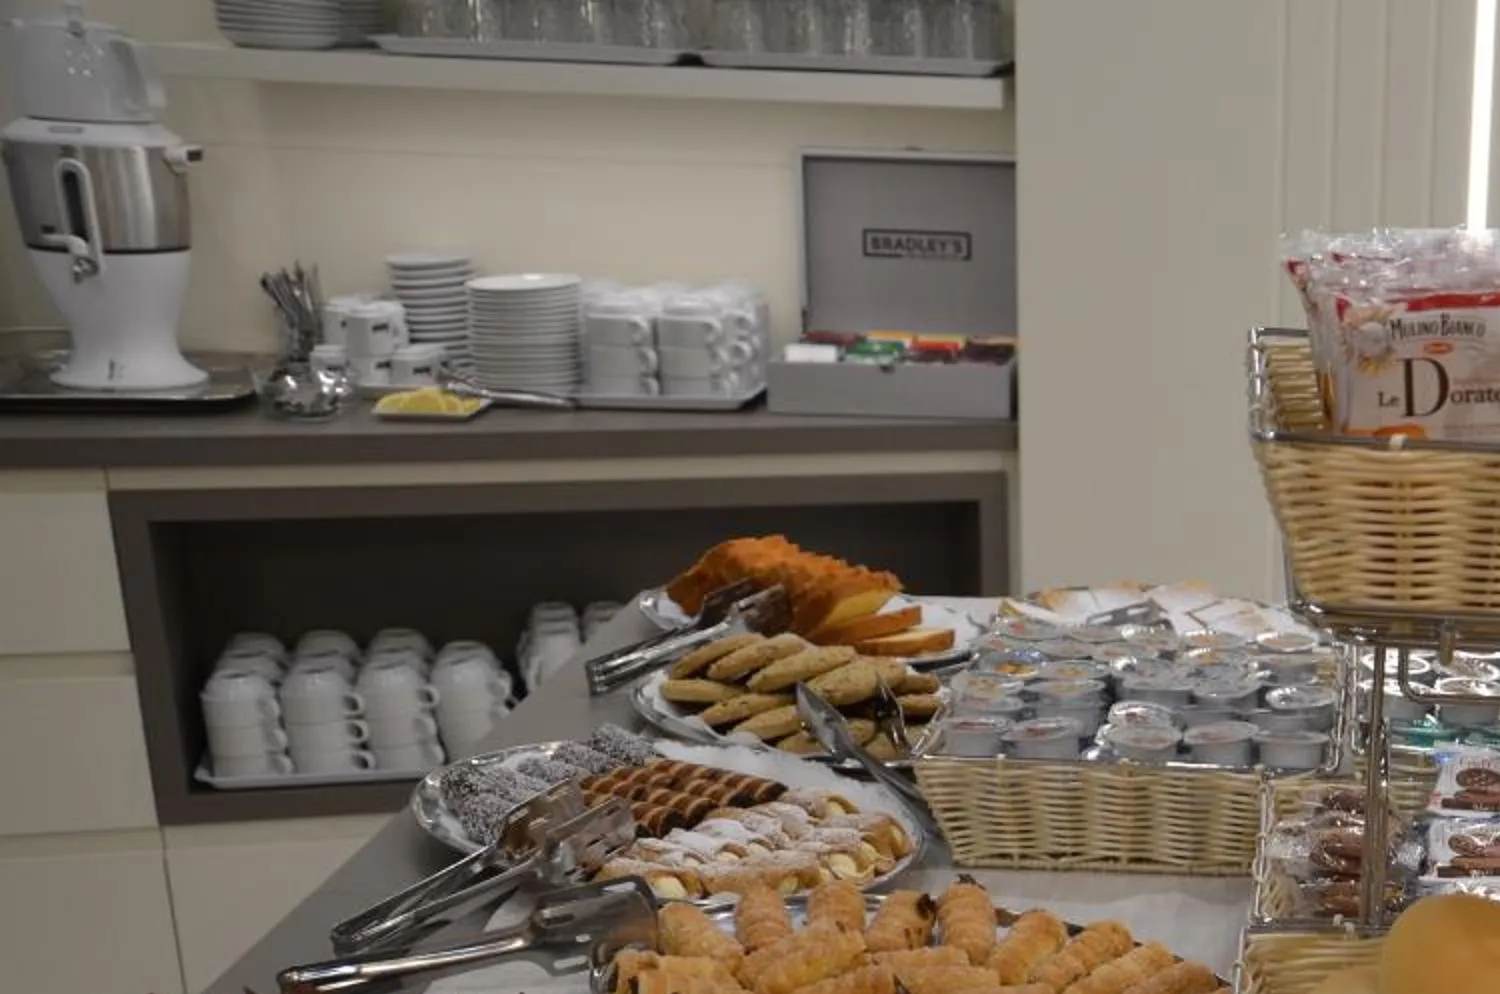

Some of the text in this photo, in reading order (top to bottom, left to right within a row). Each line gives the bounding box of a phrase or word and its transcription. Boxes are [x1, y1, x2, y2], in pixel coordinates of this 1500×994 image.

[870, 236, 963, 254] BRADLEY'S
[1389, 317, 1439, 341] MULINO
[1377, 391, 1401, 408] Le
